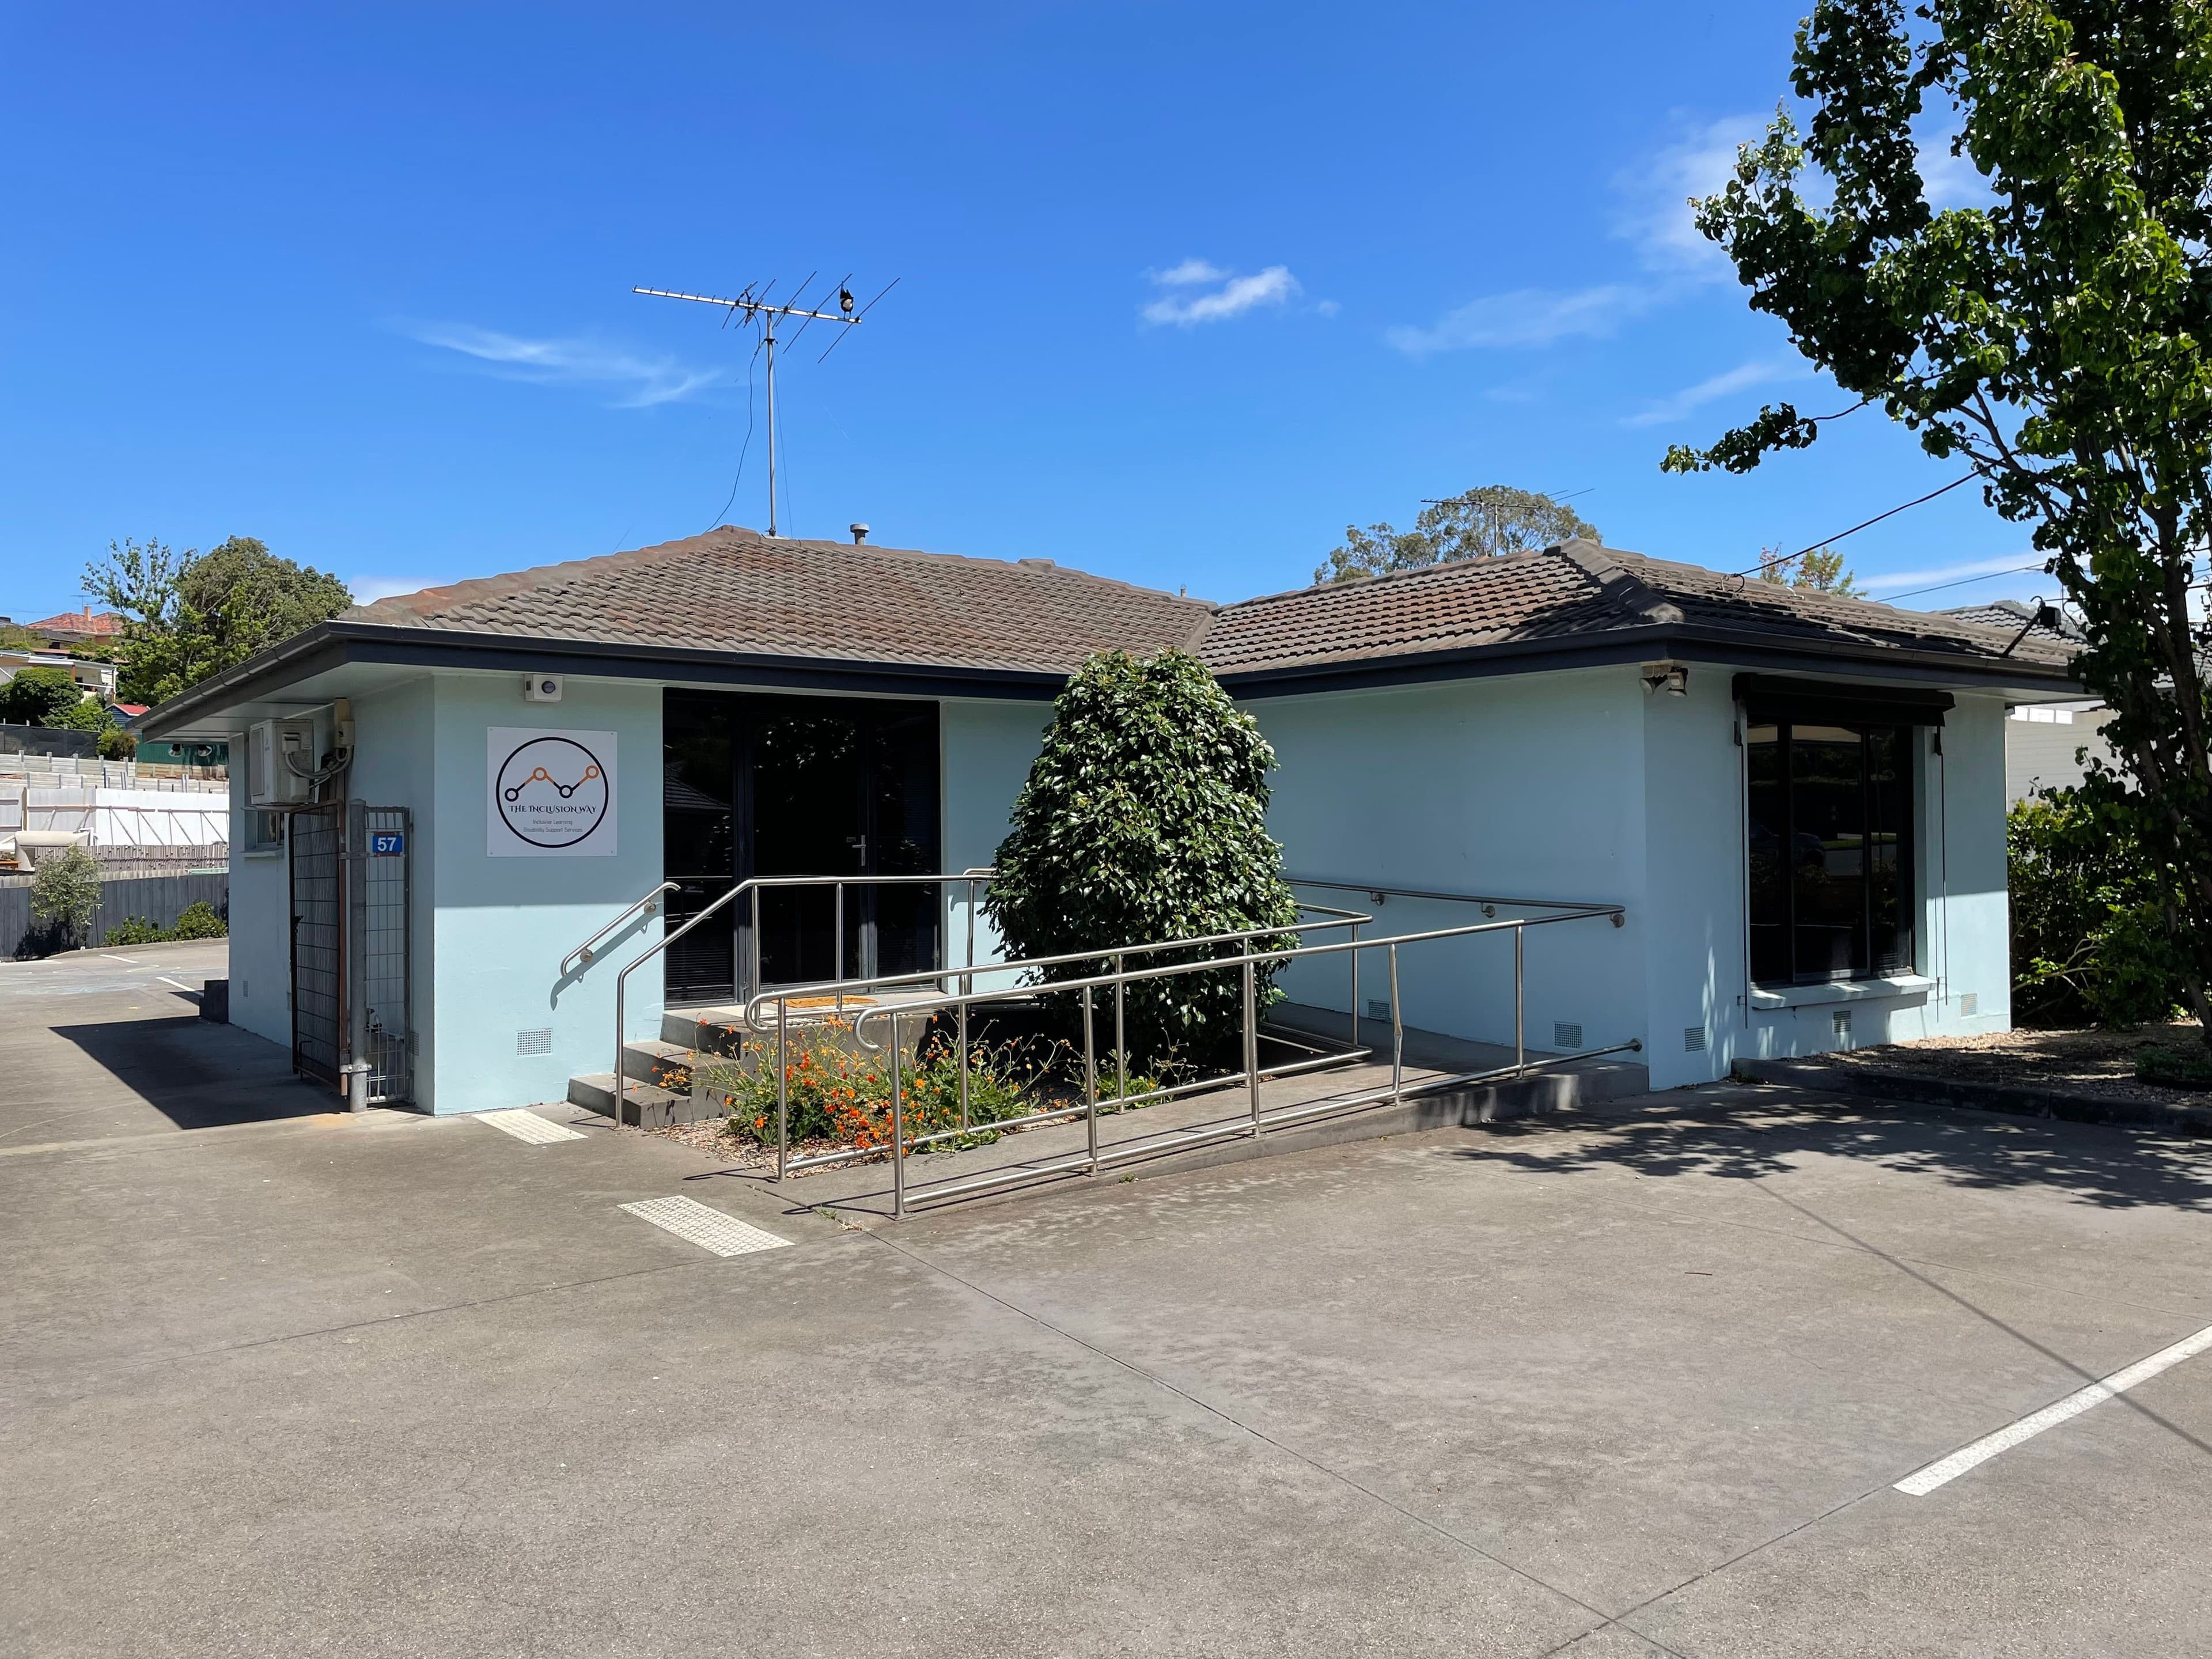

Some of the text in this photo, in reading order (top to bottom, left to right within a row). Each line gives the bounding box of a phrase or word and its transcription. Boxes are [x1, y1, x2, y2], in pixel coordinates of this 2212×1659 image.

[508, 805, 596, 814] THE INCLUSION WAY
[377, 837, 396, 852] 57
